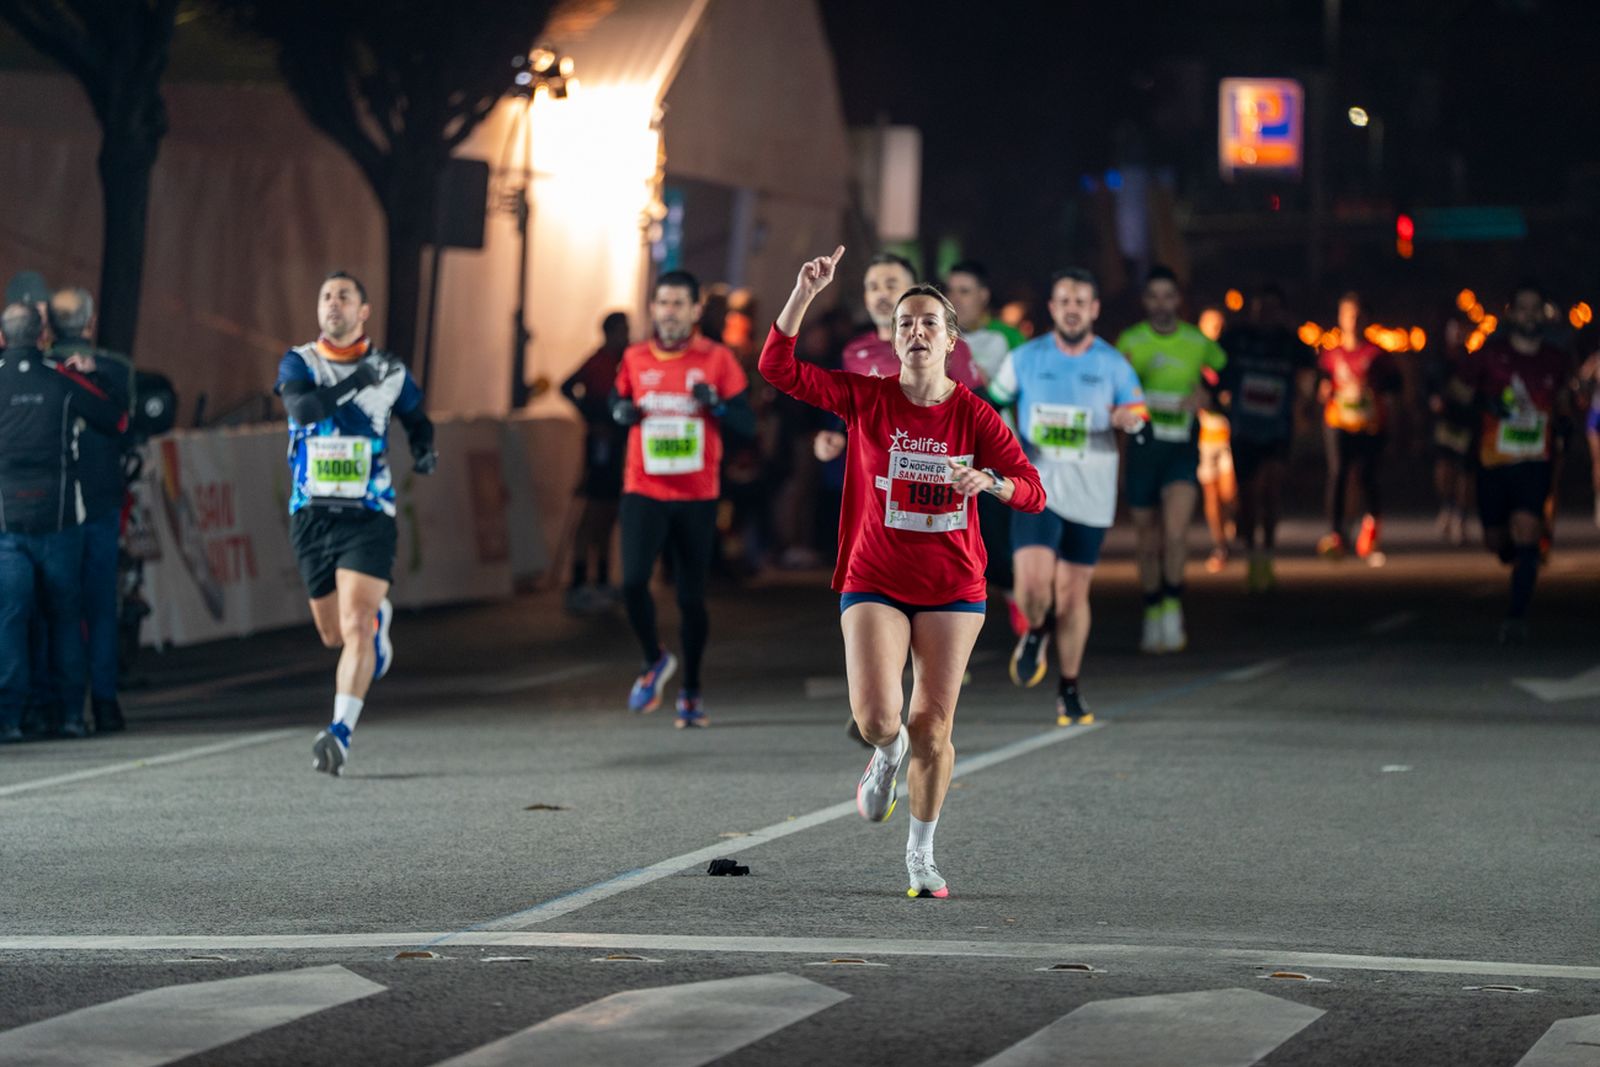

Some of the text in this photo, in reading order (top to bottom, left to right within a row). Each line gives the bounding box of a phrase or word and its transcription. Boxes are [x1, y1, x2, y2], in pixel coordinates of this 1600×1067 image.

[902, 437, 948, 454] califas
[909, 462, 935, 473] NOCHE
[936, 465, 947, 474] DE
[899, 470, 916, 481] SAN
[907, 483, 954, 507] 1981
